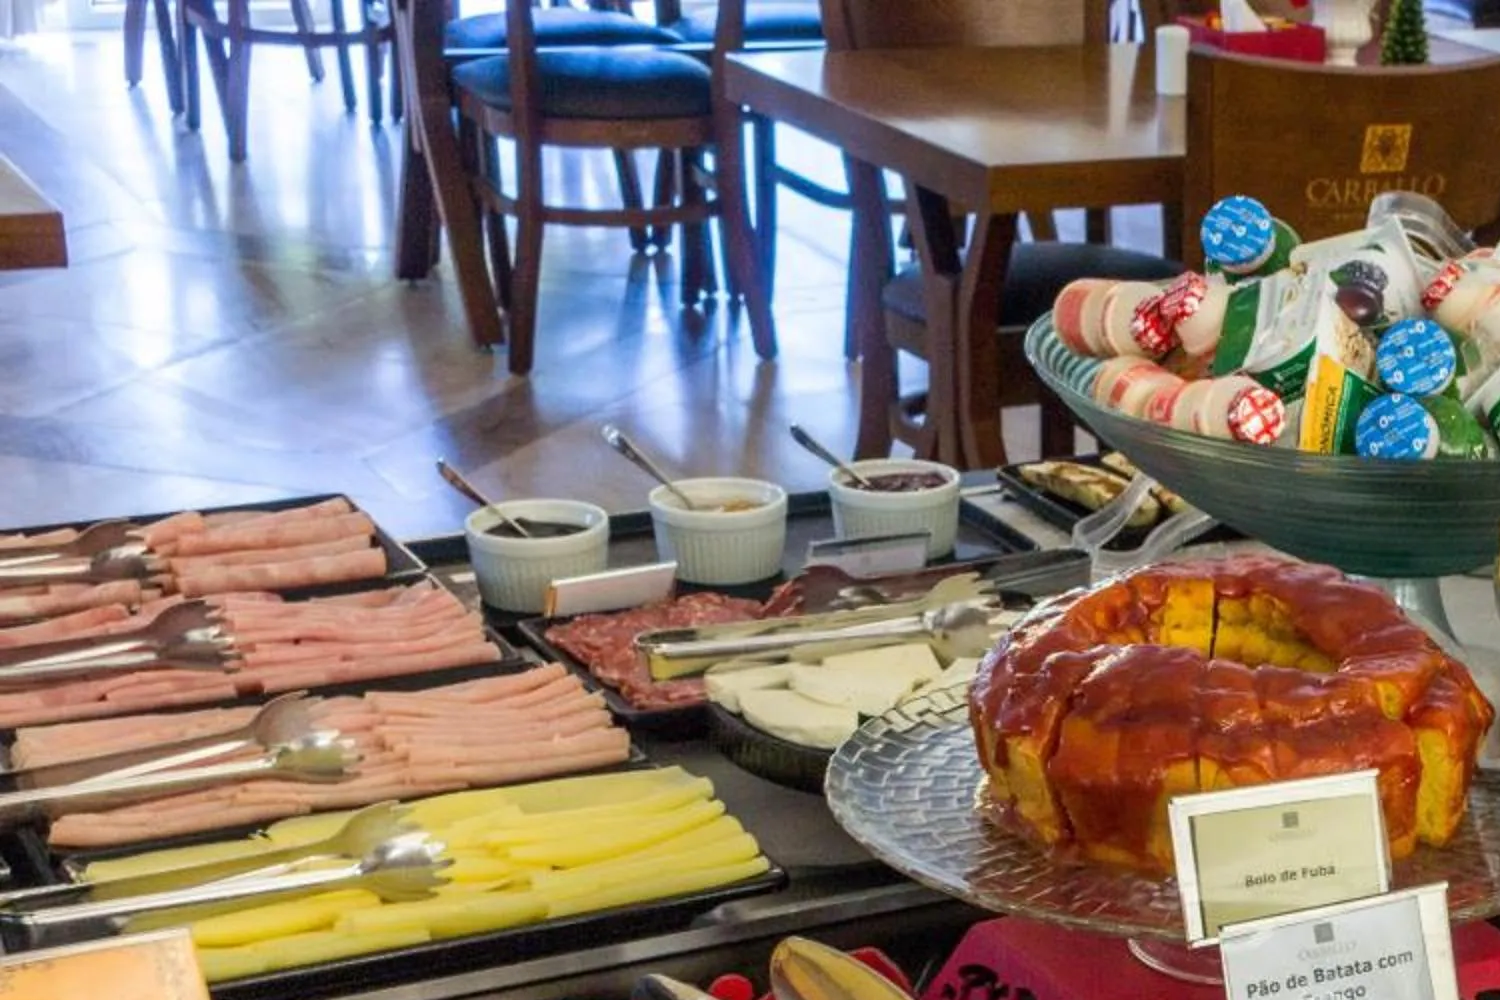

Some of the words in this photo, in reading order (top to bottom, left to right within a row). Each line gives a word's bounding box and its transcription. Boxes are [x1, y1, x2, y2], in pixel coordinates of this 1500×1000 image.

[1245, 874, 1277, 888] Bolo
[1280, 869, 1297, 882] de
[1246, 979, 1281, 999] Pão
[1286, 975, 1309, 991] de
[1313, 960, 1373, 983] Batata
[1378, 950, 1414, 969] com
